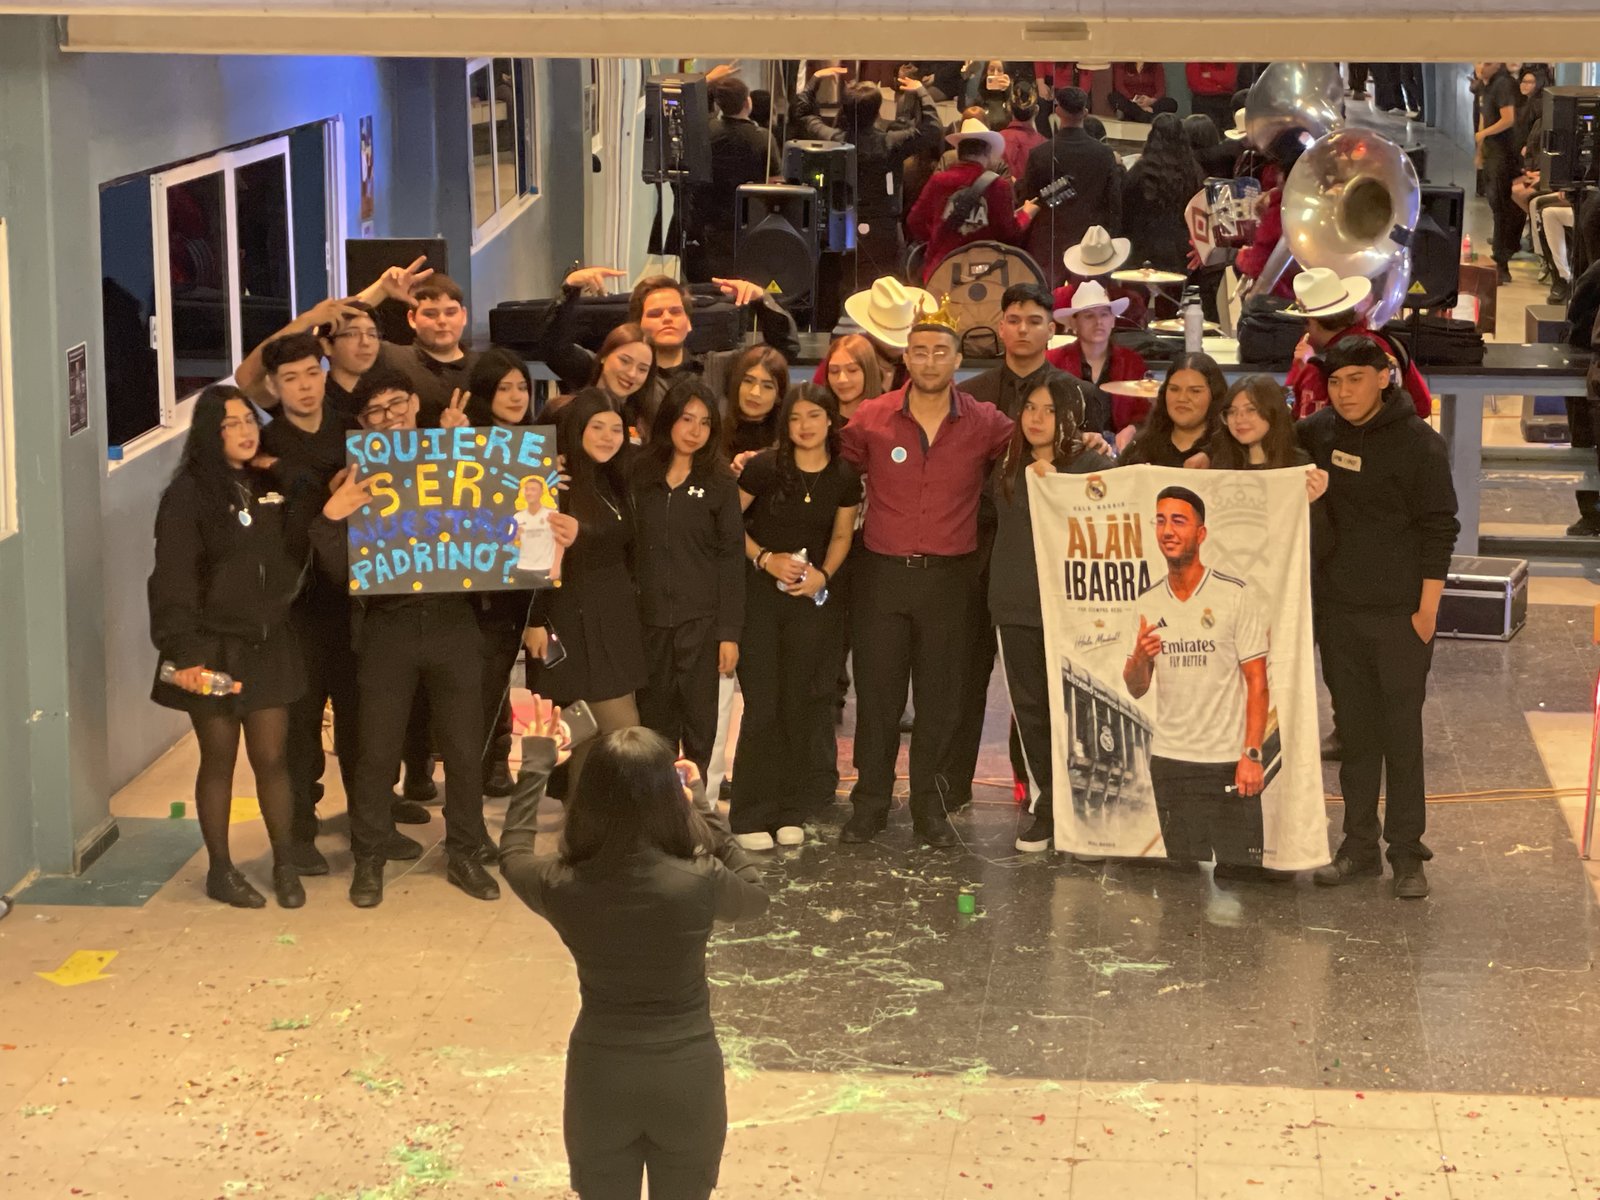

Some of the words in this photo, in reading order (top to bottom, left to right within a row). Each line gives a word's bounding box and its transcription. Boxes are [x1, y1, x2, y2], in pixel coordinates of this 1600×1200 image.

[370, 461, 485, 518] SER
[349, 508, 518, 547] NUESTRO
[1067, 512, 1143, 559] ALAN
[1064, 560, 1151, 601] IBARRA
[1160, 638, 1216, 655] Emirates
